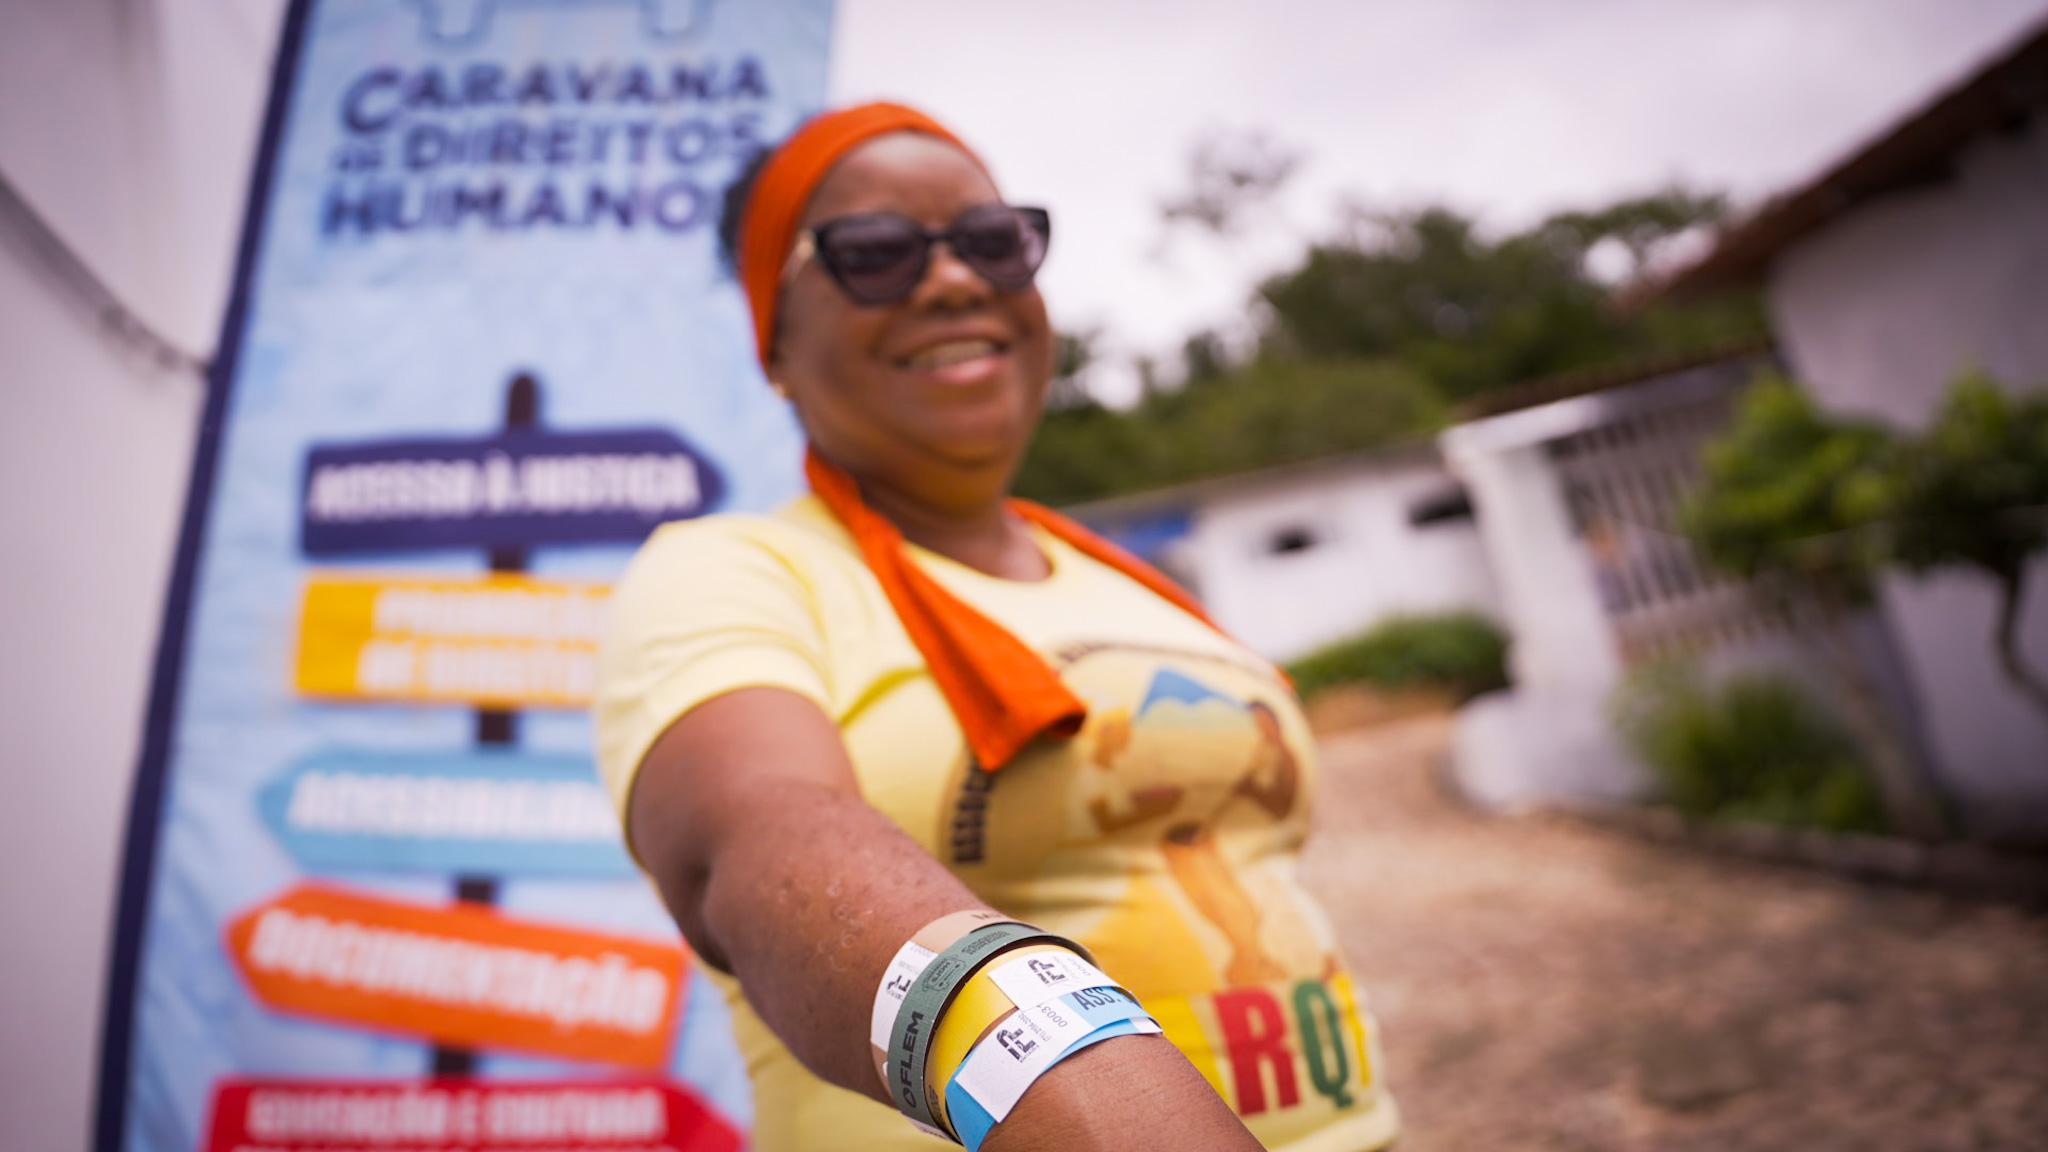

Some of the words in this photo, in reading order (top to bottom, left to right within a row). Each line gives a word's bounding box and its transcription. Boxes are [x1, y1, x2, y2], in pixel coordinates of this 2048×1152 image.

[341, 57, 768, 135] CARAVANA
[405, 114, 763, 170] DIREITOS
[322, 180, 726, 236] HUMANO
